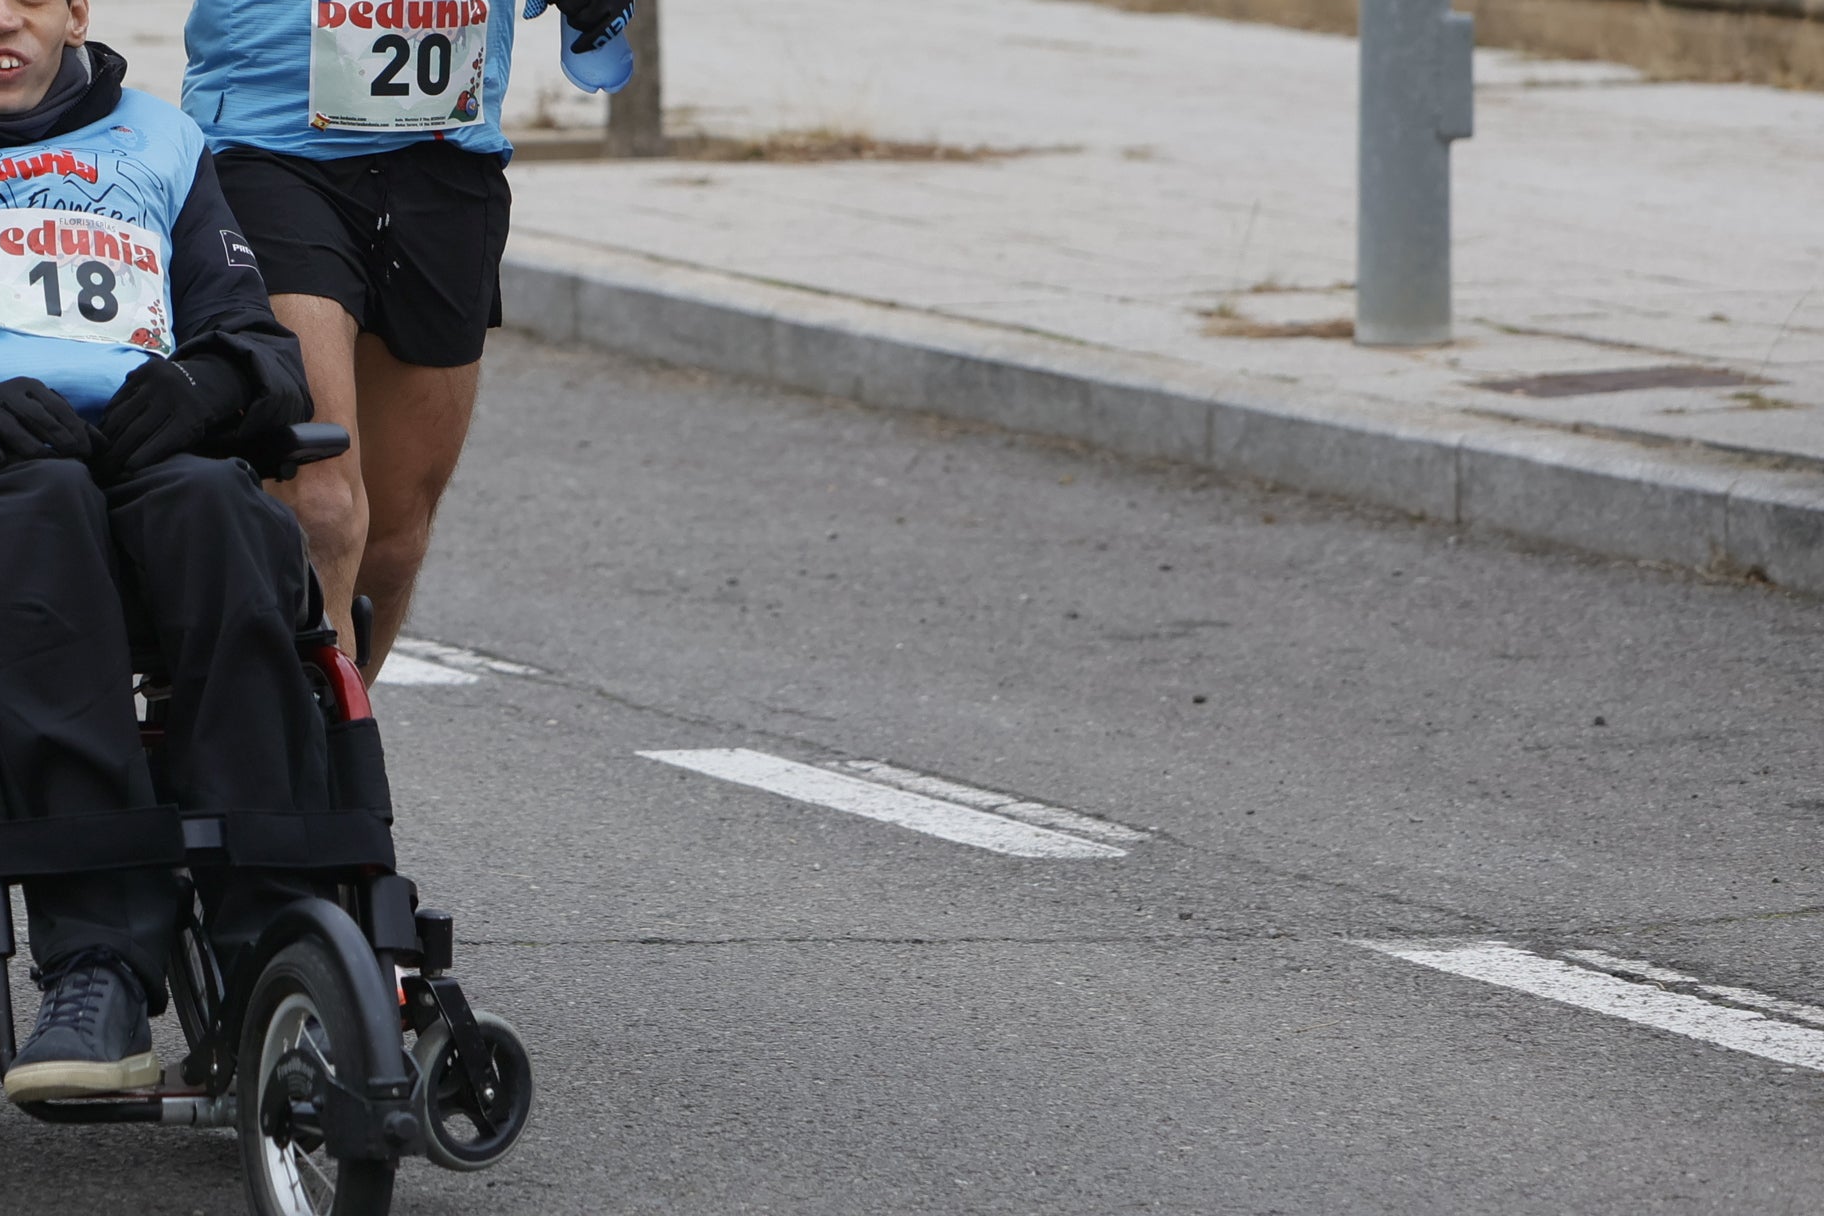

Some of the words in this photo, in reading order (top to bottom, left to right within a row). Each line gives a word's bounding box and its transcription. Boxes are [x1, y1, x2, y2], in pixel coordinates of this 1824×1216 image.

[370, 32, 452, 97] 20
[59, 217, 117, 234] FLORISTERÍAS
[28, 260, 119, 323] 18
